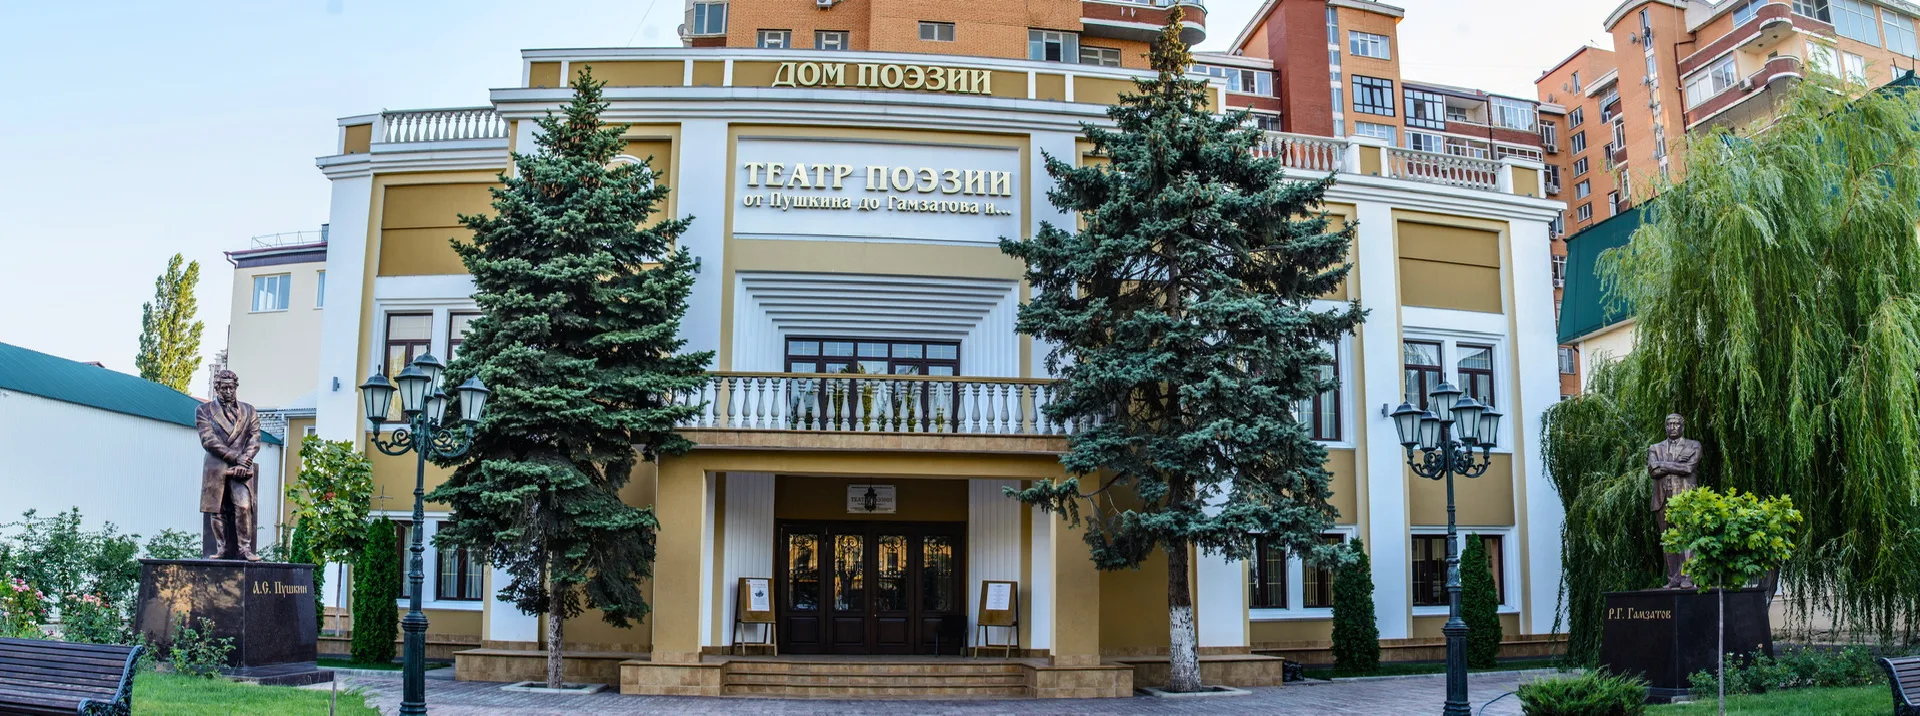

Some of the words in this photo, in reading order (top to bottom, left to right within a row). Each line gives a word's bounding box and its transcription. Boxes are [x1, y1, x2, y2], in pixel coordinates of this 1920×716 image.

[772, 62, 846, 87] ДОМ
[857, 63, 992, 95] ПОЭЗИИ
[744, 162, 853, 189] ТЕАТР
[865, 165, 1012, 197] ПОЭЗИИ
[743, 194, 764, 207] от
[769, 192, 851, 211] Пушкина
[857, 197, 880, 211] до
[887, 195, 979, 214] Гамзатова
[253, 581, 272, 595] А.С.
[274, 582, 308, 598] Пушкин
[1608, 607, 1625, 620] Р.Г.
[1628, 608, 1671, 620] Гамзатов
